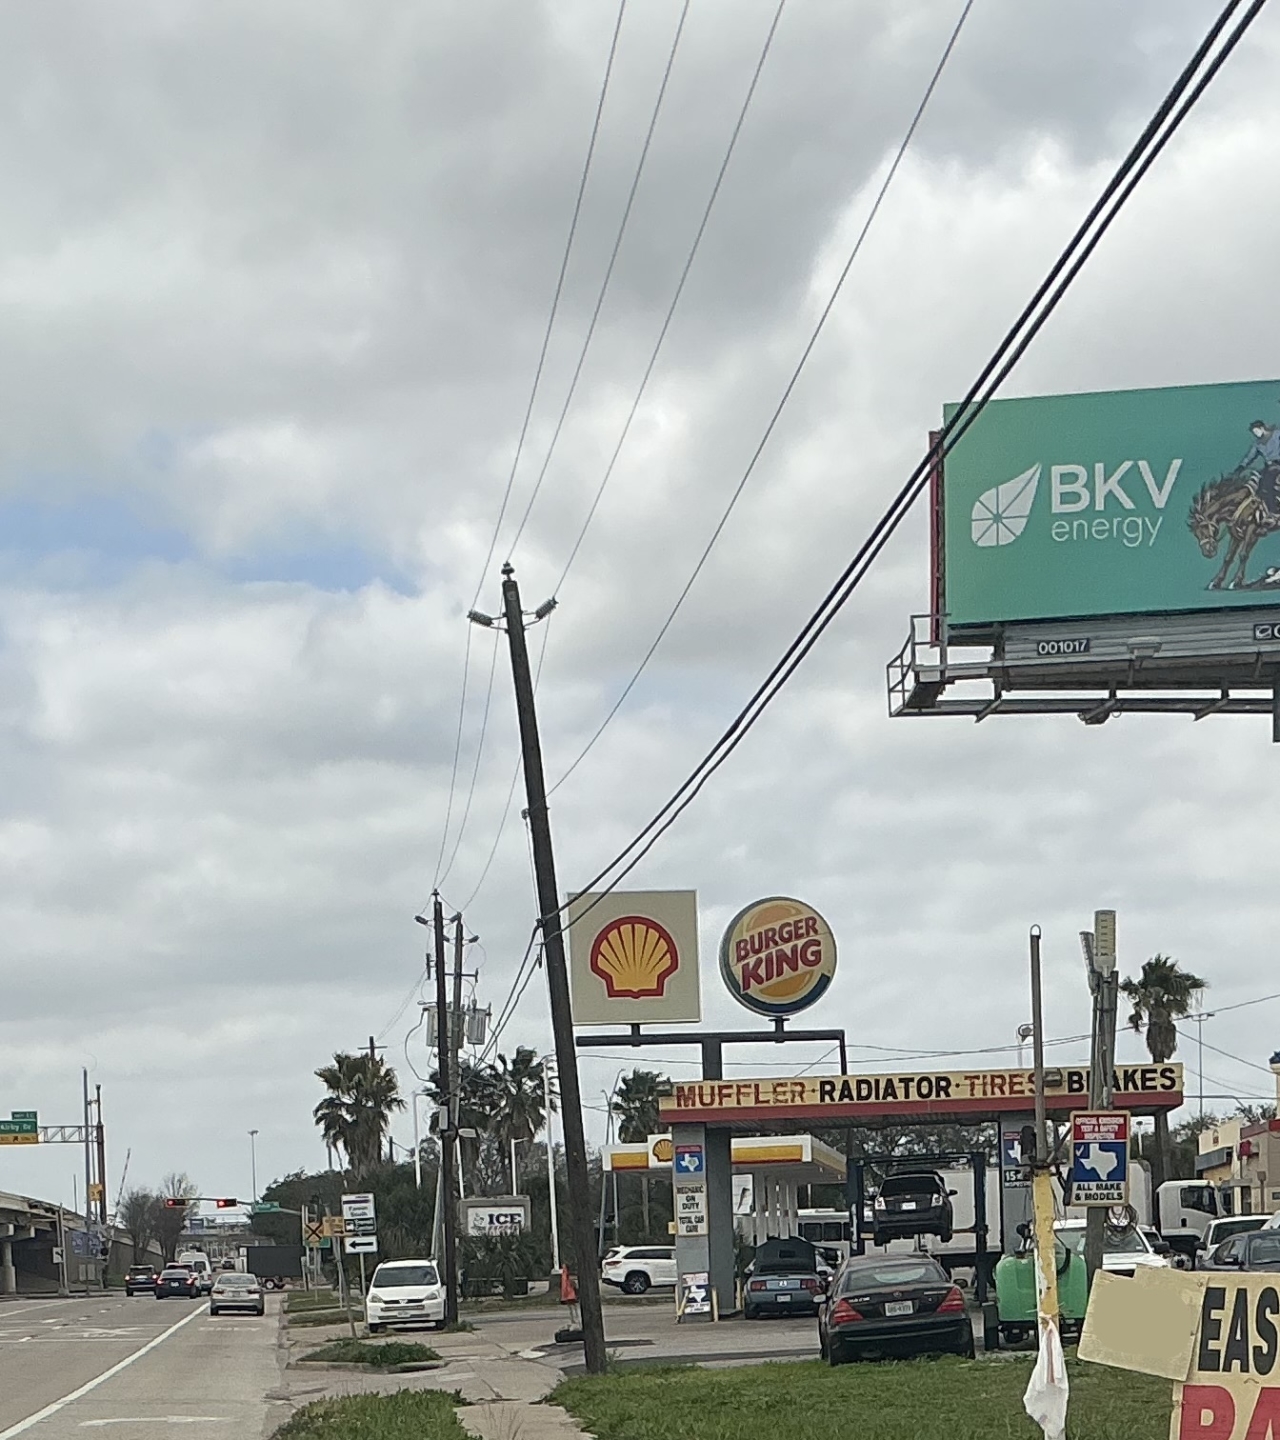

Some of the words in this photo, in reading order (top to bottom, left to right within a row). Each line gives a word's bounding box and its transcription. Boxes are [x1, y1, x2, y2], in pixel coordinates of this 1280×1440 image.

[1051, 459, 1183, 513] BKV
[1051, 516, 1163, 547] energy
[1038, 639, 1087, 655] 001017
[736, 916, 819, 963] BURGER
[742, 939, 822, 992] KING
[676, 1080, 805, 1109] MUFFLER
[820, 1076, 952, 1103] RADIATOR
[1067, 1067, 1177, 1093] BAKES
[1076, 1183, 1091, 1191] ALL
[1096, 1183, 1121, 1191] MAKE
[1085, 1192, 1123, 1201] MODELS
[682, 1202, 699, 1210] DUTY
[488, 1213, 521, 1225] ICE
